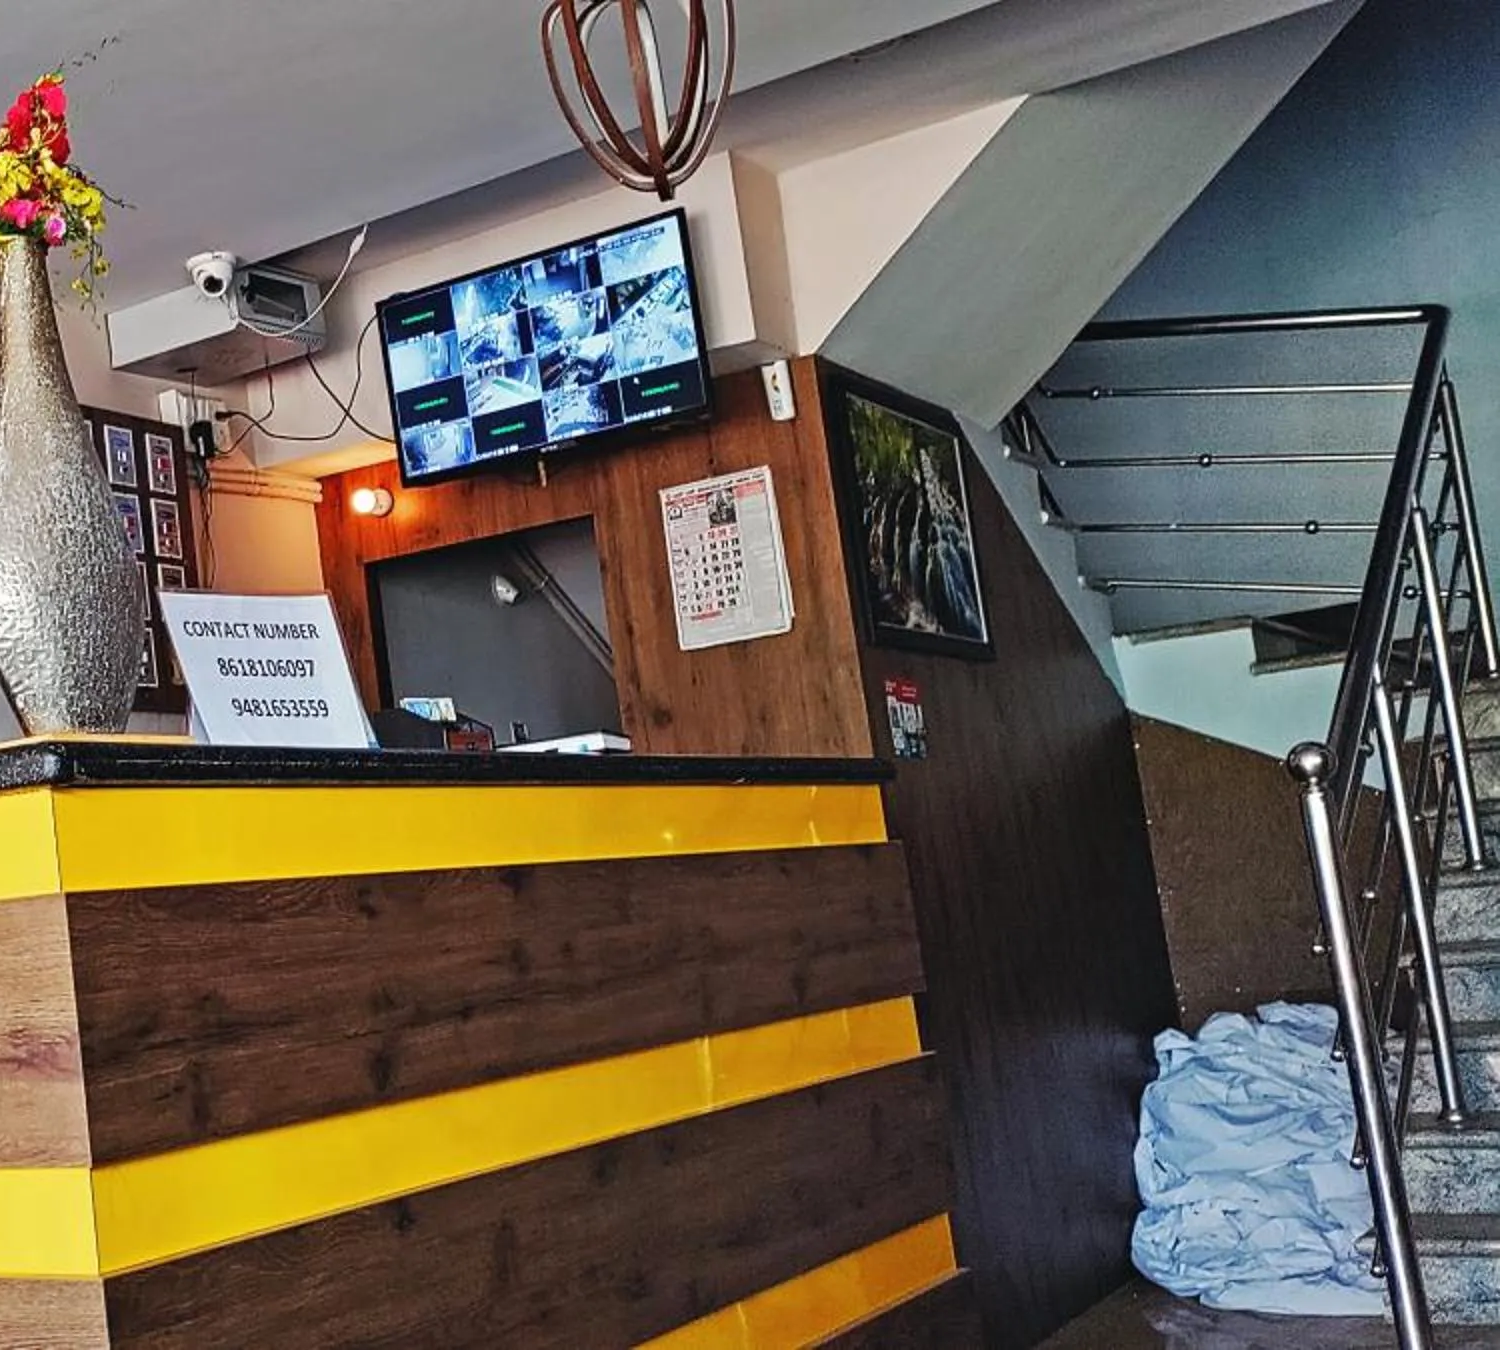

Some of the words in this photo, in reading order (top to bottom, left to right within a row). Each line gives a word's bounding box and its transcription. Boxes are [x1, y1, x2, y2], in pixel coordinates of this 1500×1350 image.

[183, 621, 250, 638] CONTACT
[253, 623, 319, 639] NUMBER
[217, 657, 316, 677] 8618106097
[231, 697, 329, 717] 9481653559
